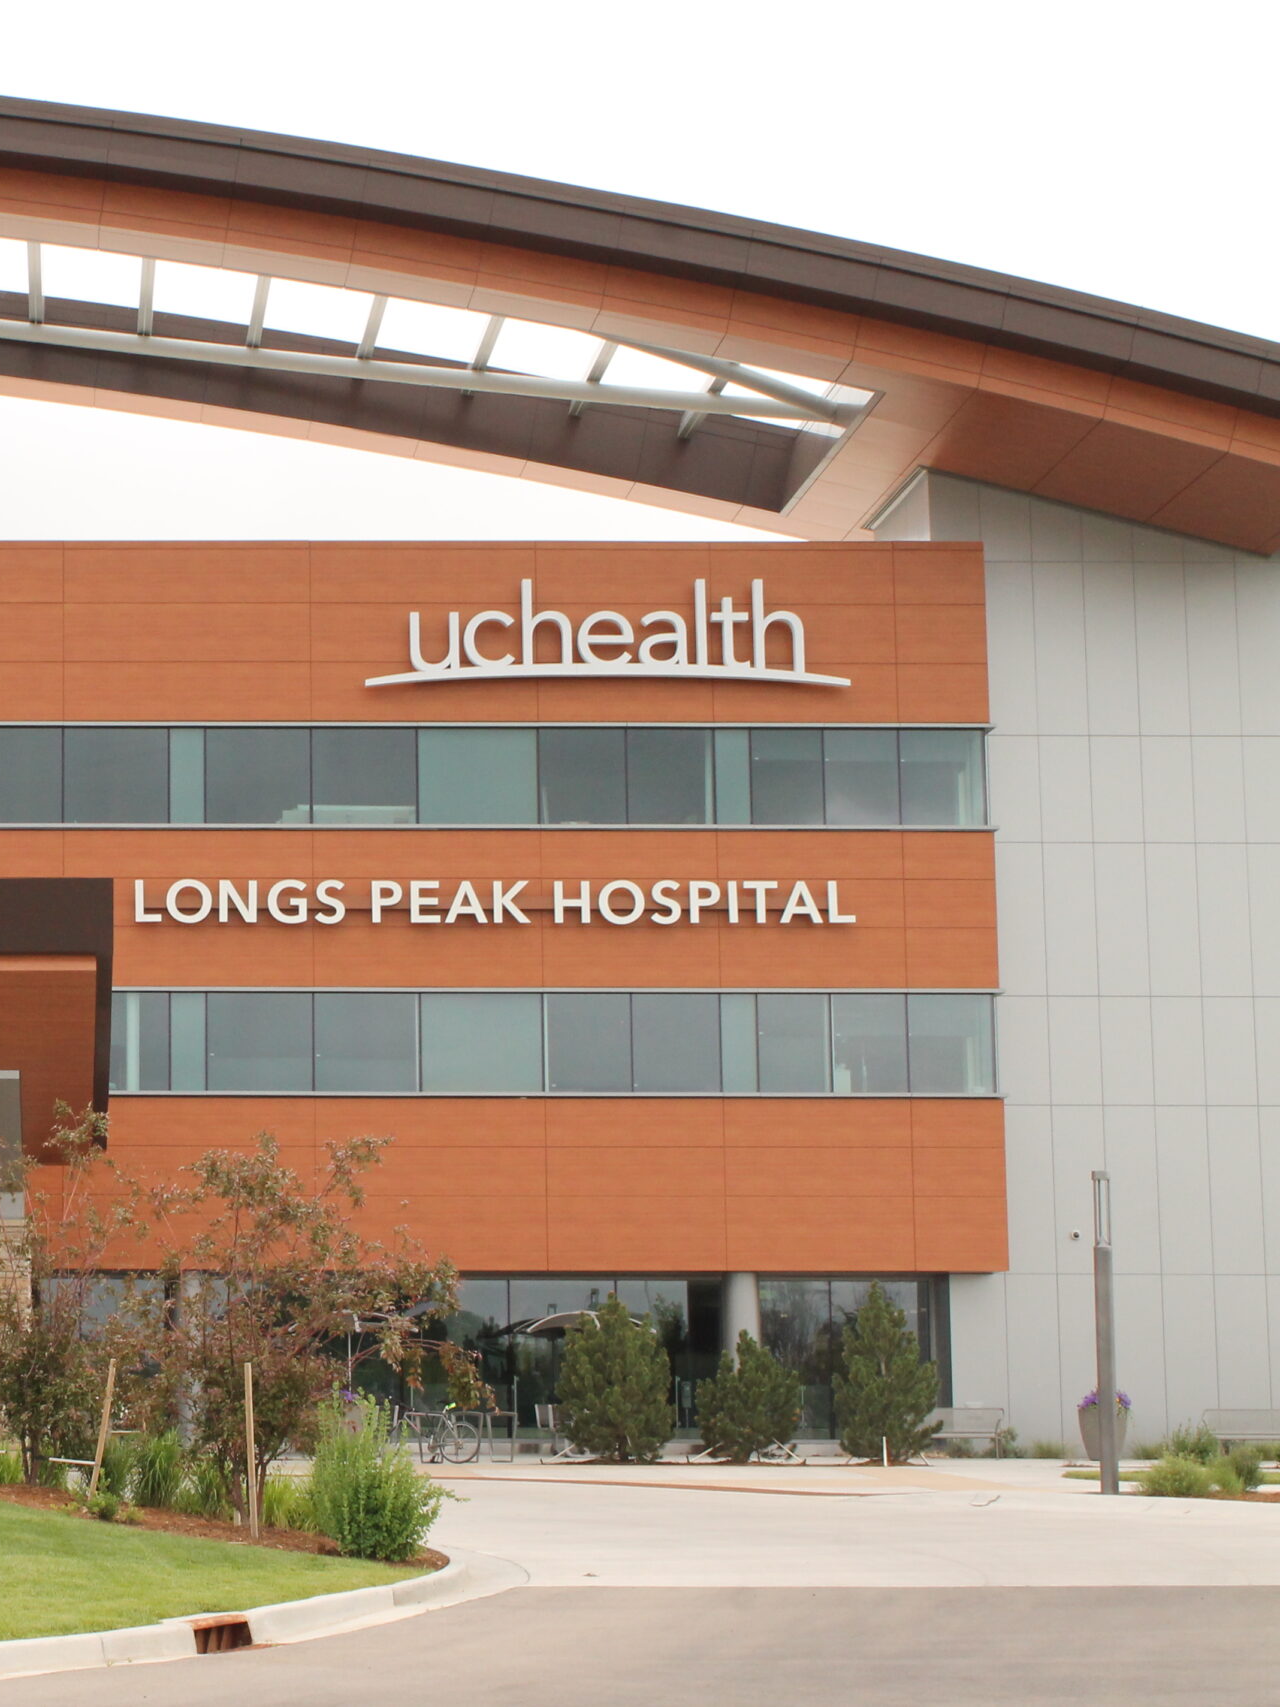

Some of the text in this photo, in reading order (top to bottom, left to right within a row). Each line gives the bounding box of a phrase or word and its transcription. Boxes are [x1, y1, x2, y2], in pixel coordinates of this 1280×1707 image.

[409, 578, 806, 673] uchealth
[134, 878, 856, 925] LONGS PEAK HOSPITAL
